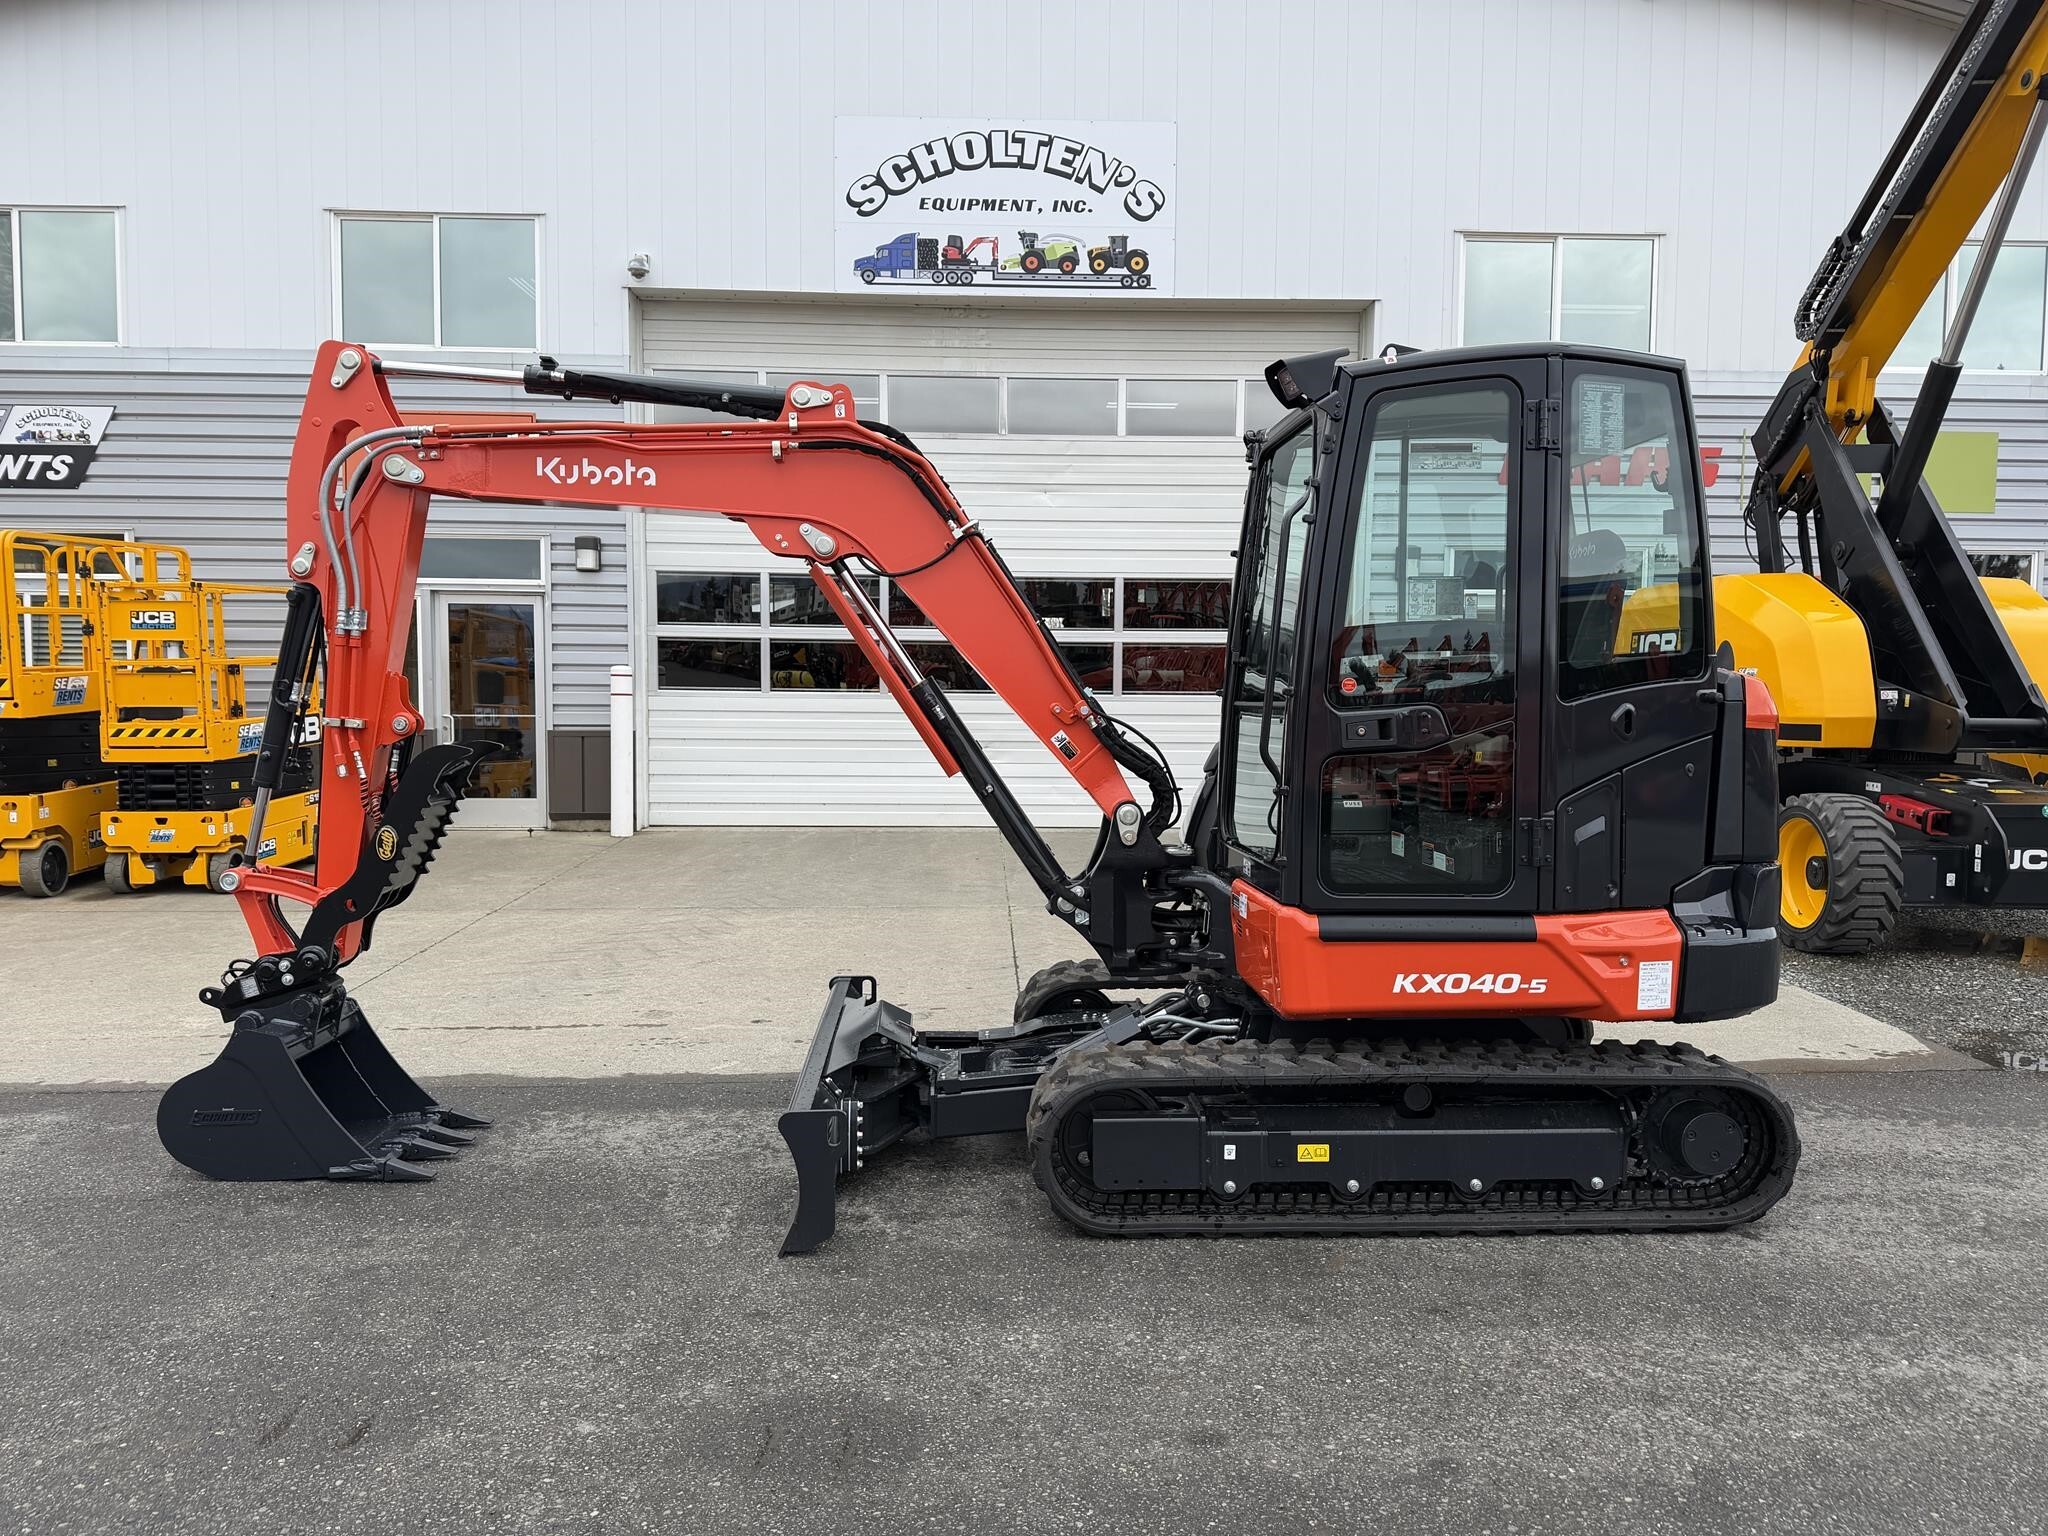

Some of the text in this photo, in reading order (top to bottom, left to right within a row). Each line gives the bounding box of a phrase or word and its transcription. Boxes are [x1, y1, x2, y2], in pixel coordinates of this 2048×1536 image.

[846, 130, 1166, 222] SCHOLTEN'S
[919, 197, 1093, 215] EQUIPMENT, INC.
[15, 407, 92, 429] SCHOLTEN'S
[0, 454, 74, 481] NTS
[536, 456, 656, 486] Kubota
[131, 611, 175, 624] JCB
[54, 678, 68, 690] SE
[57, 690, 83, 702] RENTS
[238, 726, 250, 737] SE
[258, 839, 276, 854] JCB
[1392, 973, 1548, 994] KX040-5
